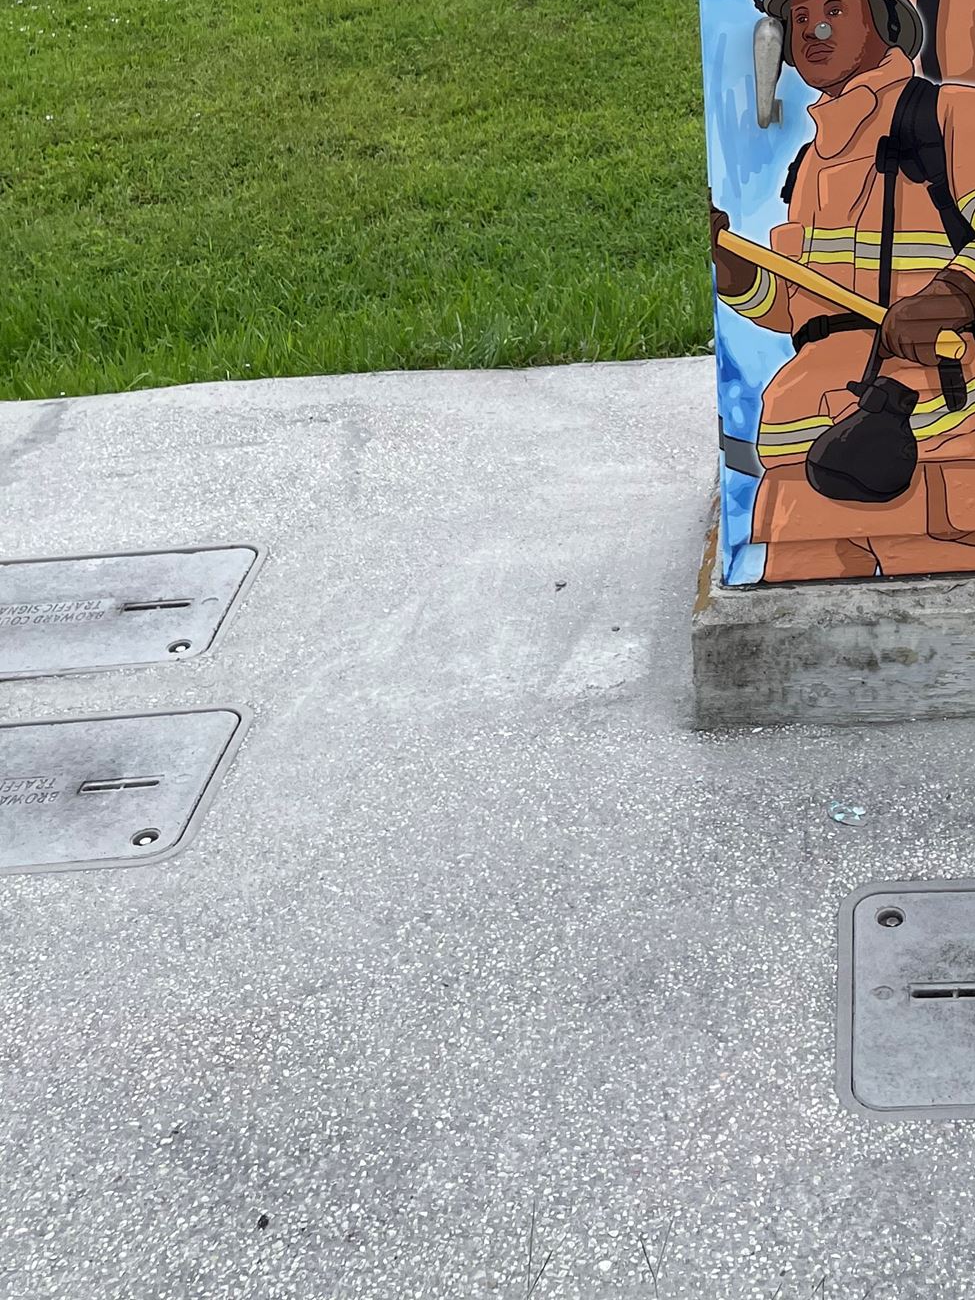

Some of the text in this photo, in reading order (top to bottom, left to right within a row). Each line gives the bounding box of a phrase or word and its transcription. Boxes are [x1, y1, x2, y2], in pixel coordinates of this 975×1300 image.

[0, 600, 101, 615] TRAFFIC SIGNA
[33, 611, 105, 624] BROWARD
[0, 777, 56, 793] TRAFFI
[0, 790, 60, 806] BROWA
